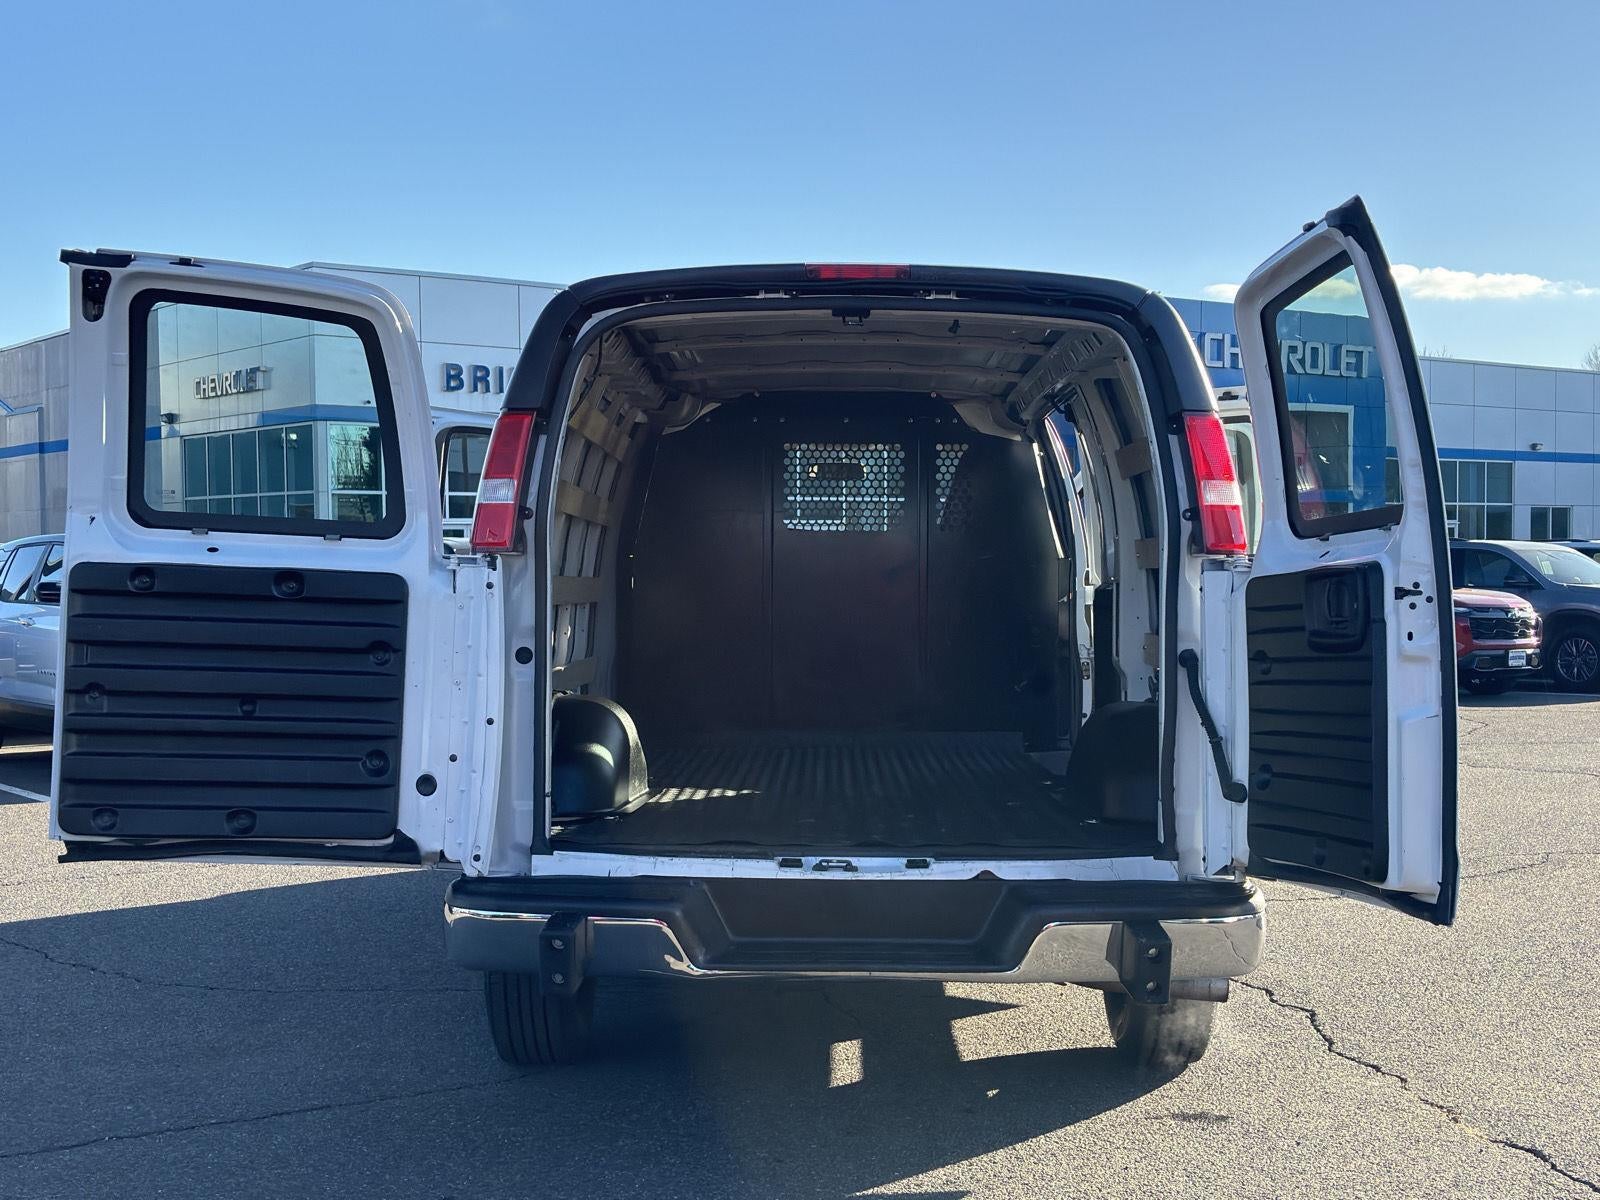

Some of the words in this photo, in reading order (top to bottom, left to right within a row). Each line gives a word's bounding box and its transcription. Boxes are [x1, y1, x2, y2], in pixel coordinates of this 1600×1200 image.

[1204, 332, 1374, 378] CHROLET
[194, 366, 272, 399] CHEVROLET
[440, 362, 514, 394] BRI
